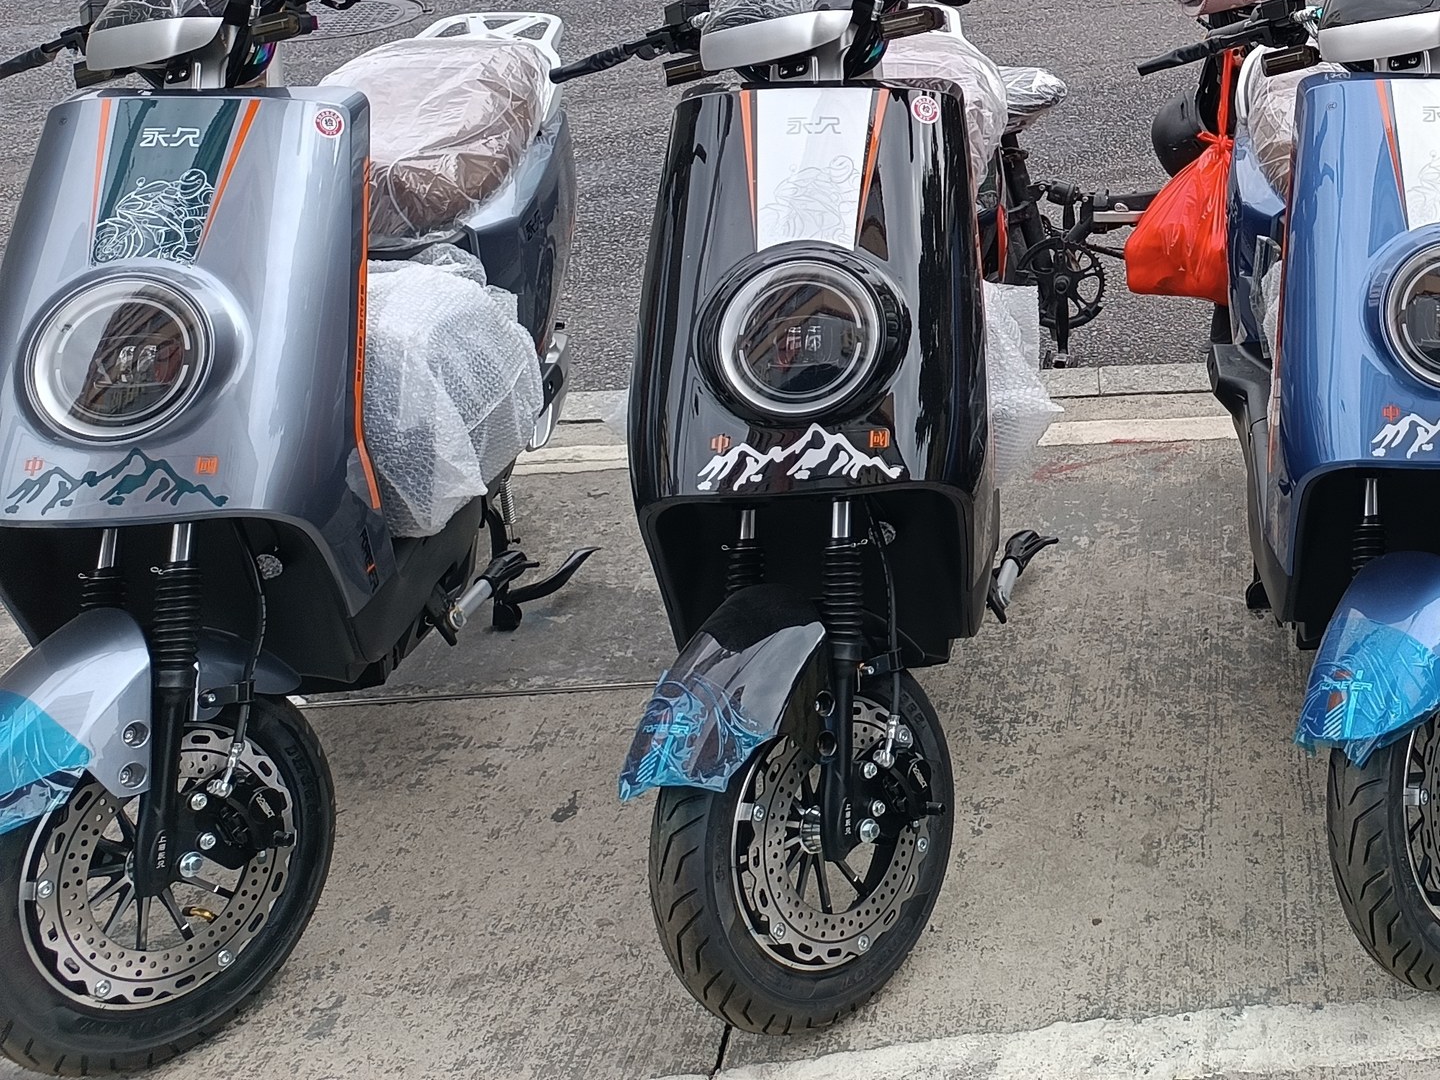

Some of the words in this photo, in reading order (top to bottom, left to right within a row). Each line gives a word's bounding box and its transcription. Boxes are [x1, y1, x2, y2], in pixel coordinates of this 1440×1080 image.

[786, 116, 841, 135] 永久
[139, 127, 200, 148] 永久
[711, 433, 732, 453] 中
[24, 455, 44, 476] 中
